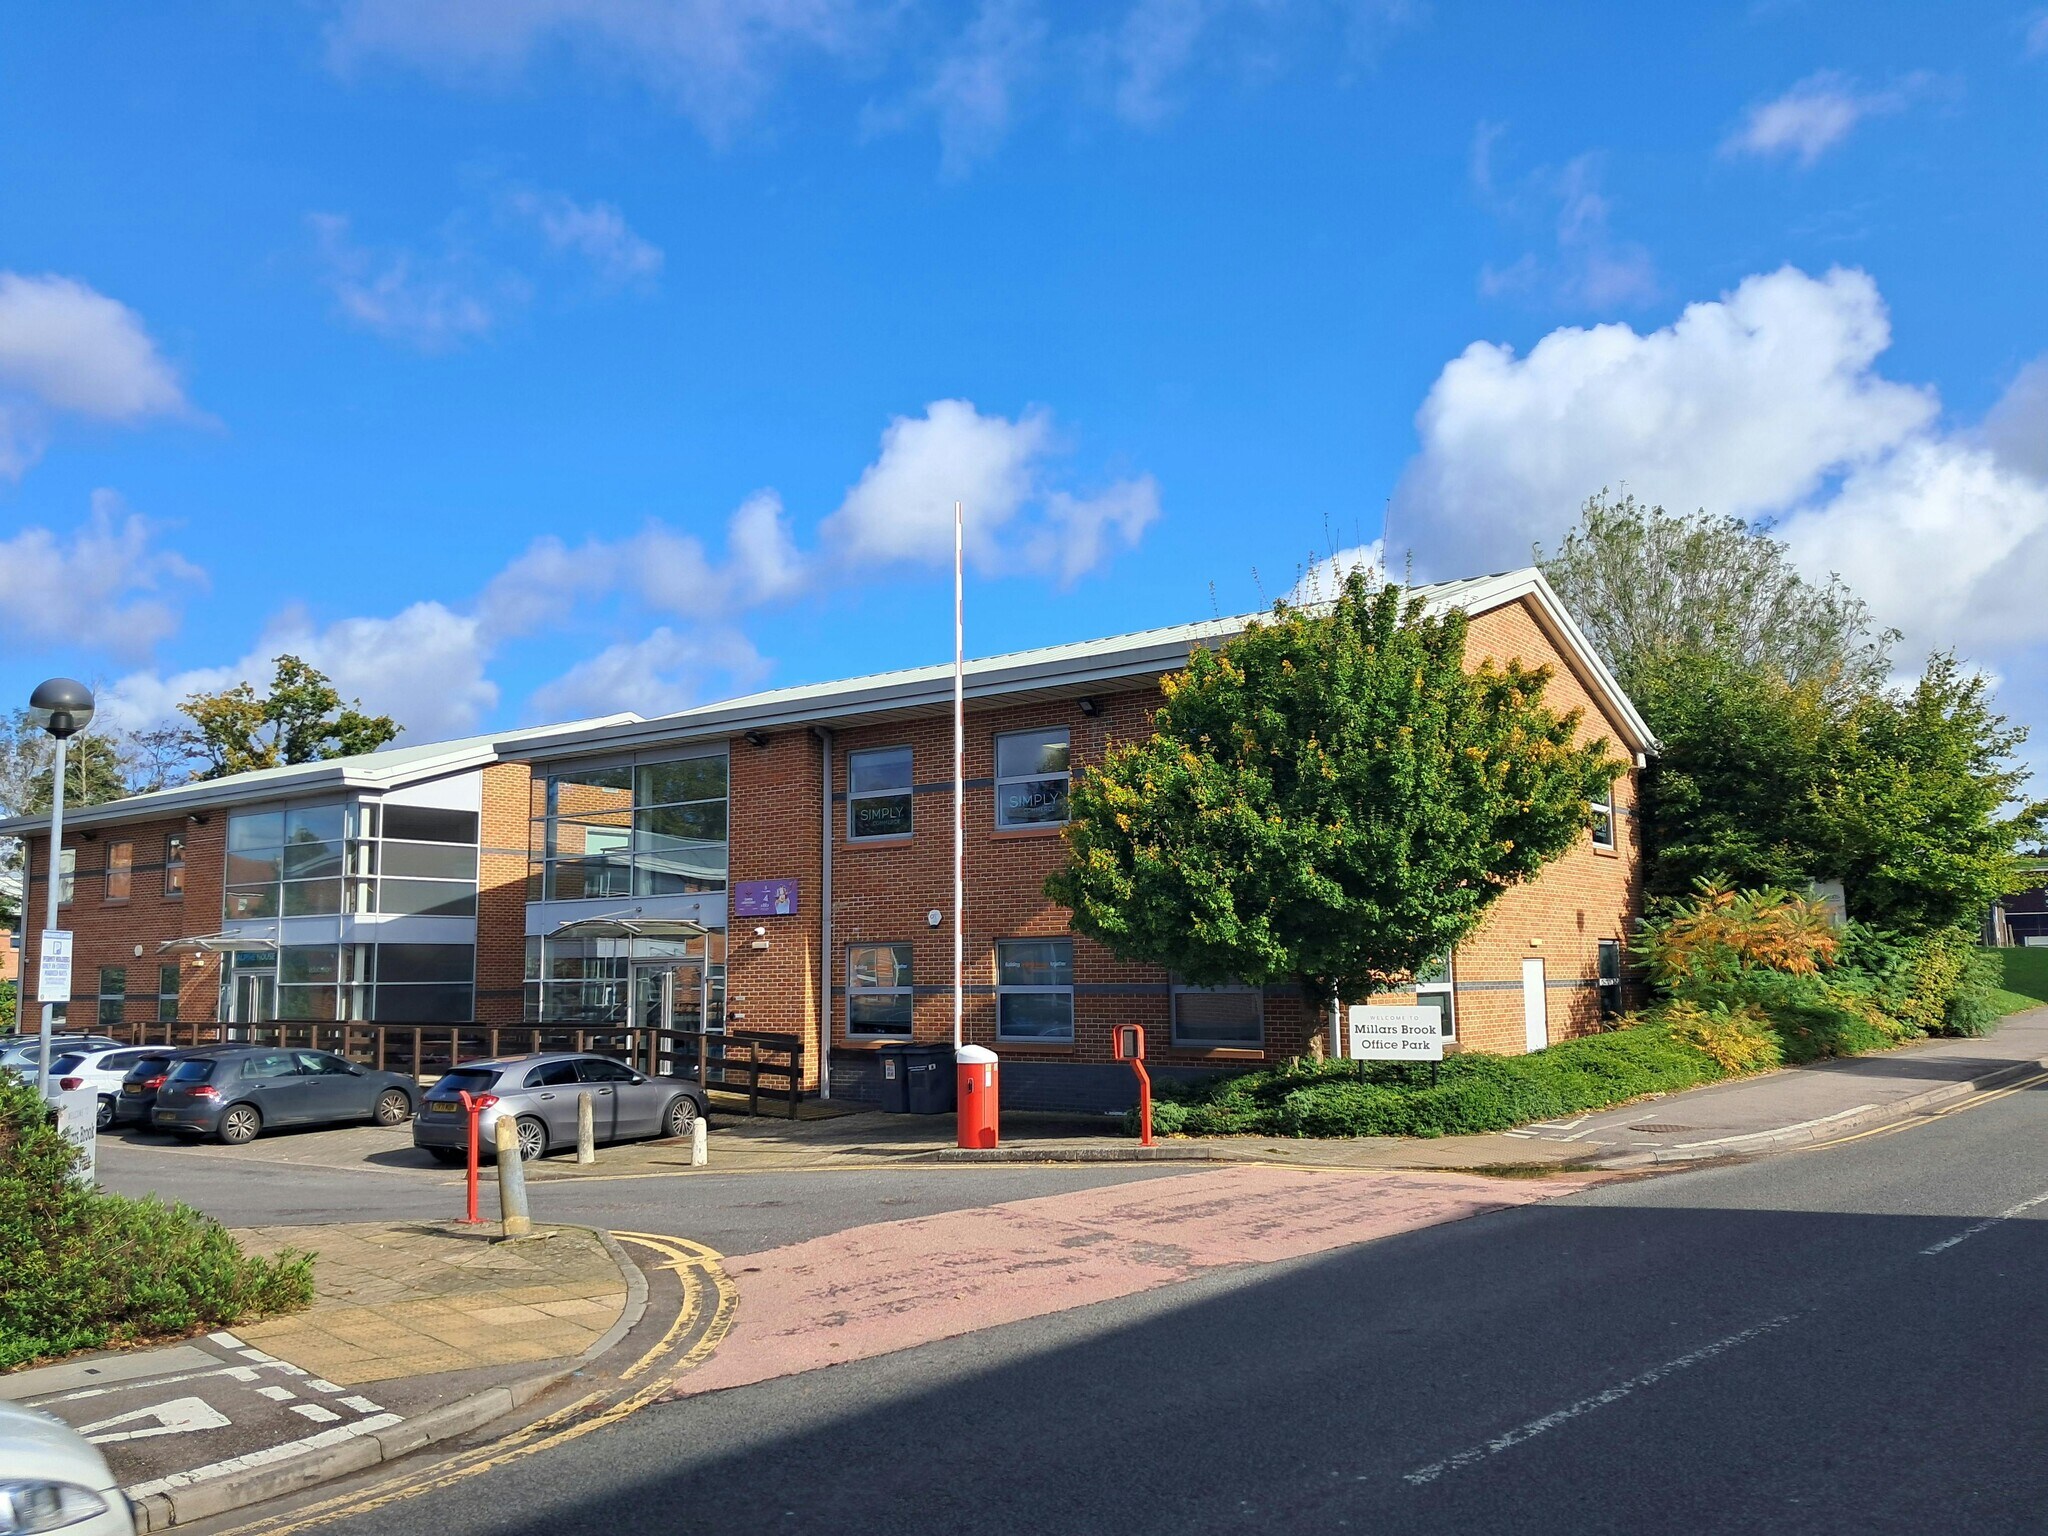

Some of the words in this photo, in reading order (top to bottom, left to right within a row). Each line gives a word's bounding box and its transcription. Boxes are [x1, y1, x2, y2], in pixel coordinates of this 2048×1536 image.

[1010, 792, 1058, 808] SIMPLY
[860, 806, 904, 821] SIMPLY
[1354, 1024, 1398, 1034] Millars
[1401, 1024, 1437, 1035] Brook
[1361, 1039, 1398, 1049] Office
[1401, 1040, 1431, 1050] Park
